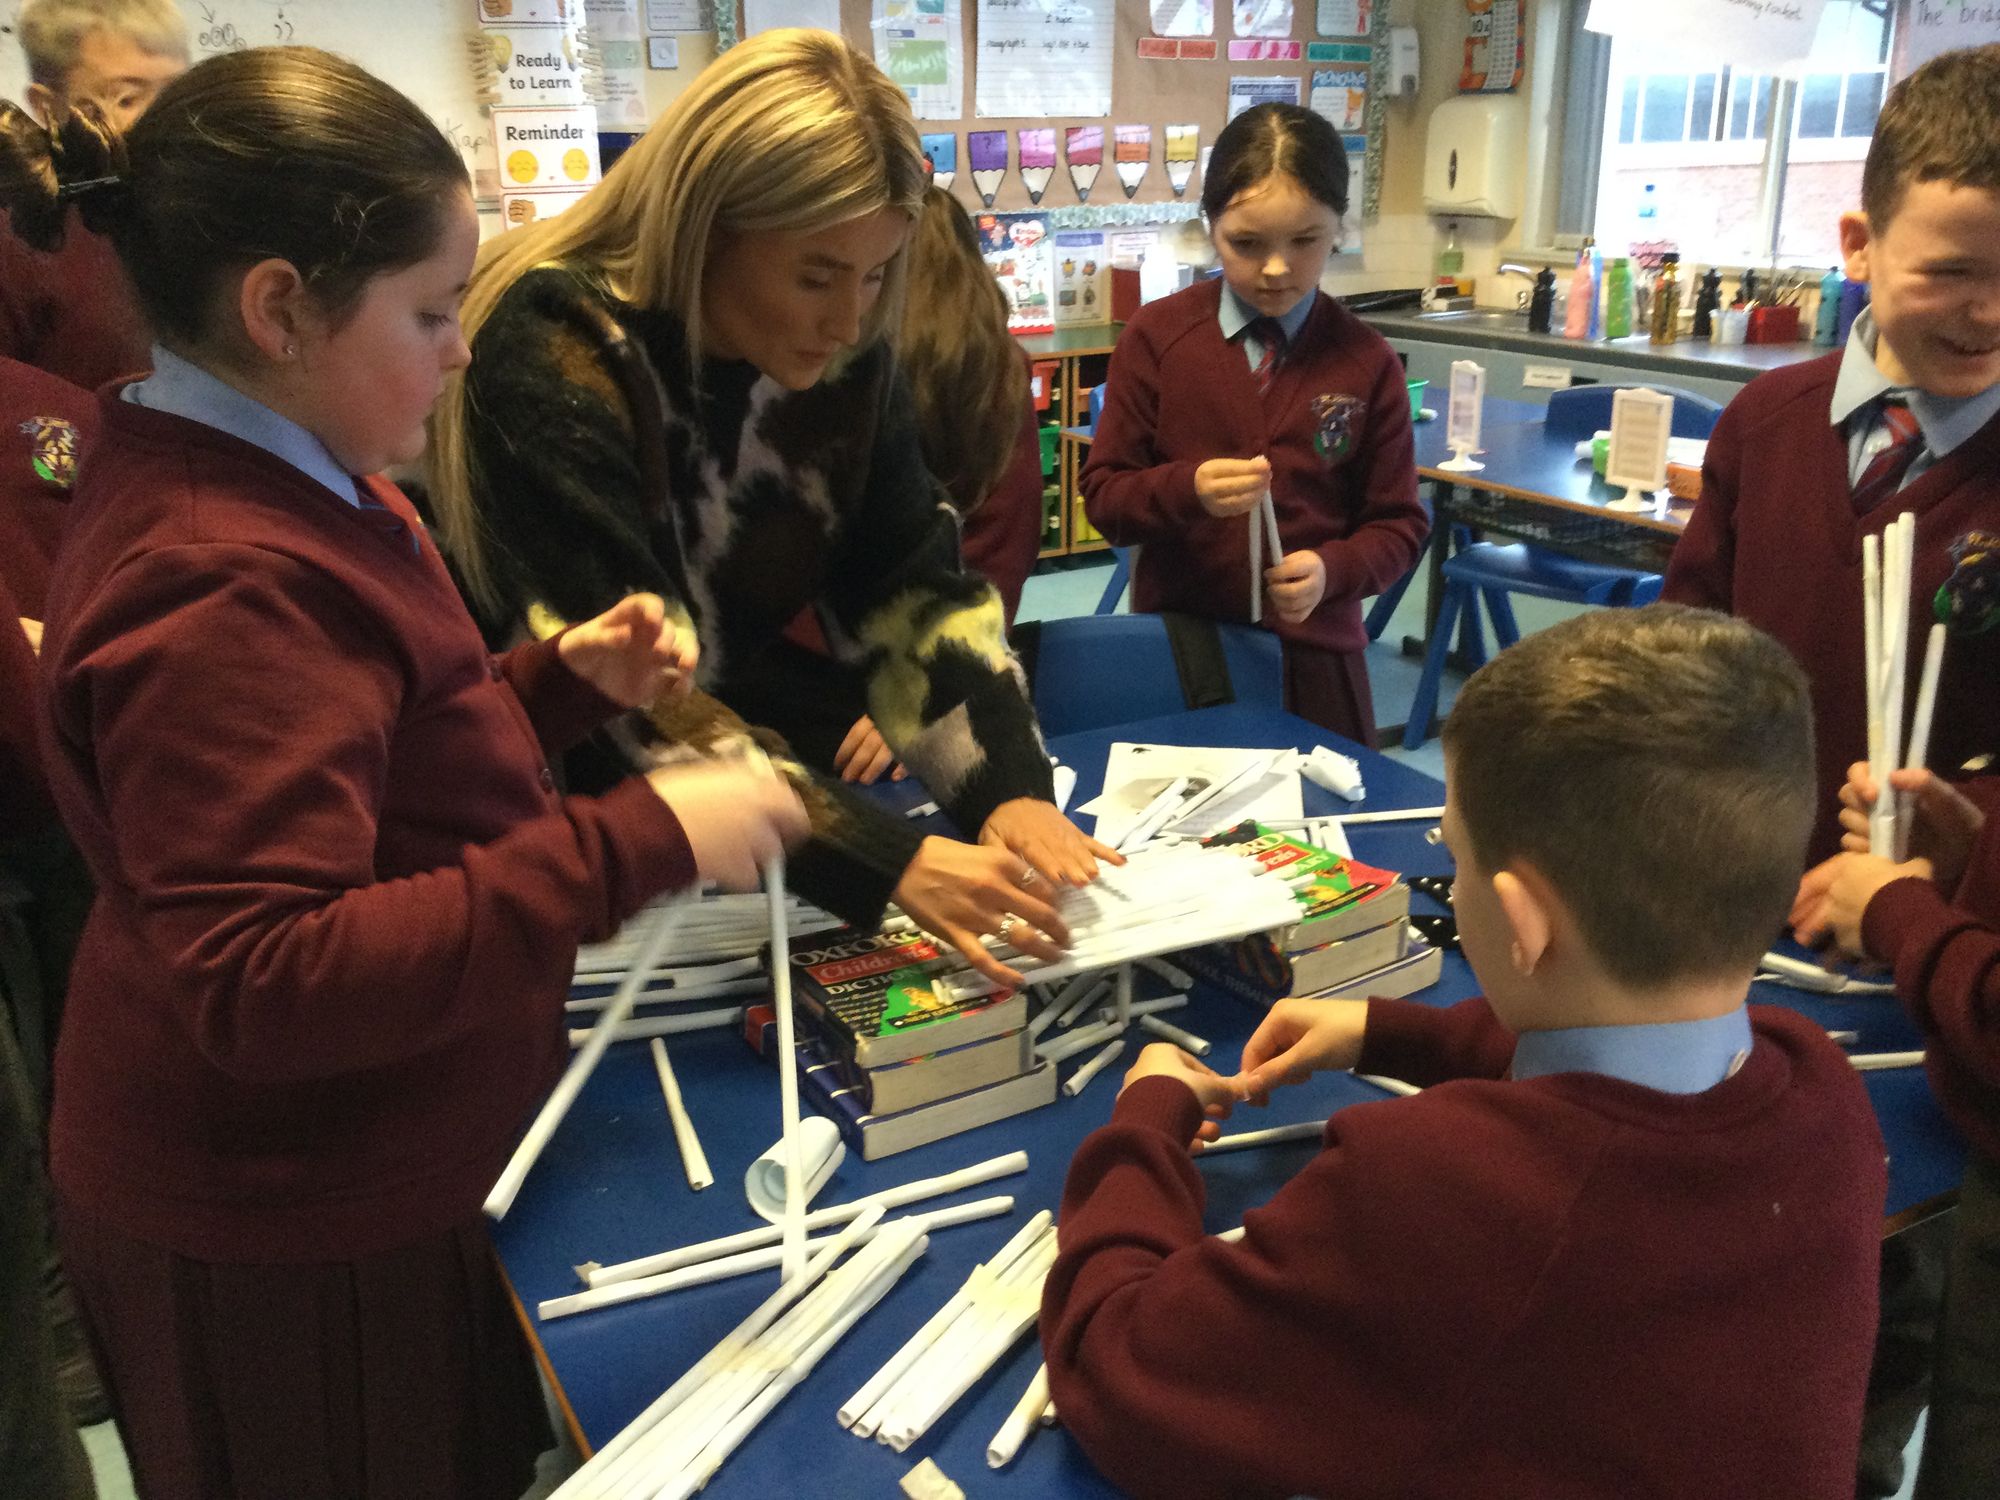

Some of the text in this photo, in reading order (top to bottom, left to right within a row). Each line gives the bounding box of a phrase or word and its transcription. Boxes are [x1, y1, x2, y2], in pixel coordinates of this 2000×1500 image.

[516, 53, 562, 70] Ready
[509, 76, 572, 90] to Learn
[505, 123, 584, 141] Reminder
